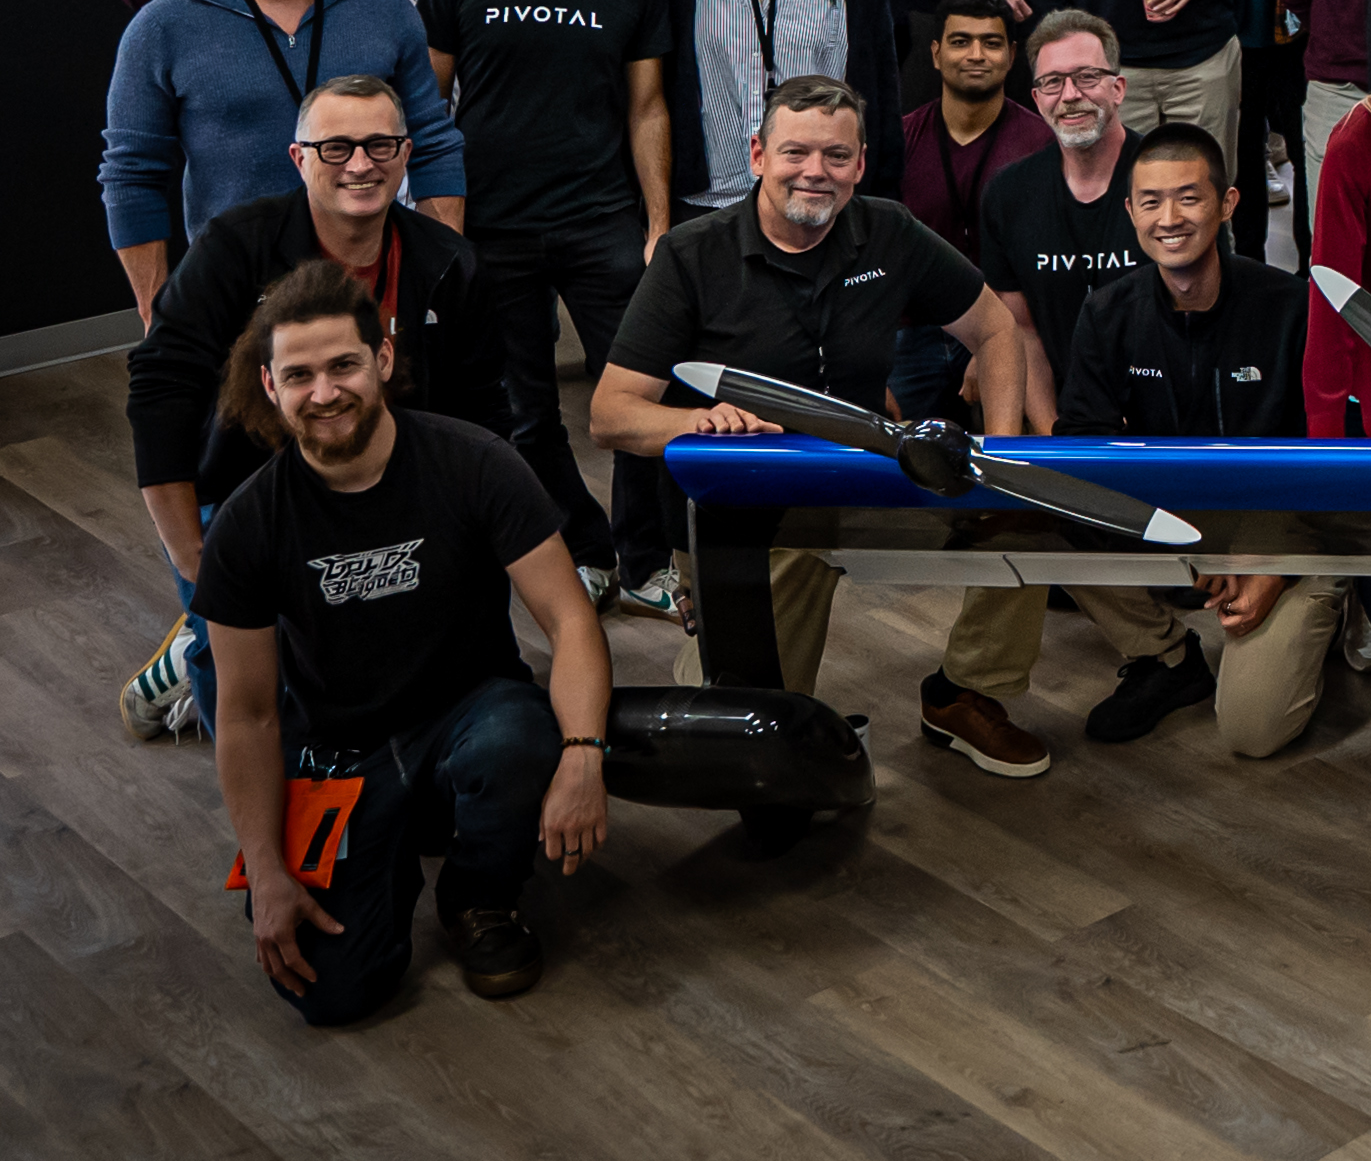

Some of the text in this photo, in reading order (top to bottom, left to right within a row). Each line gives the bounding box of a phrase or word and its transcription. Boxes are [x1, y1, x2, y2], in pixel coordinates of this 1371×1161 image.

[486, 5, 604, 29] PIVOTAL
[844, 268, 886, 287] PIVOTAL
[1129, 365, 1163, 378] IVOTA
